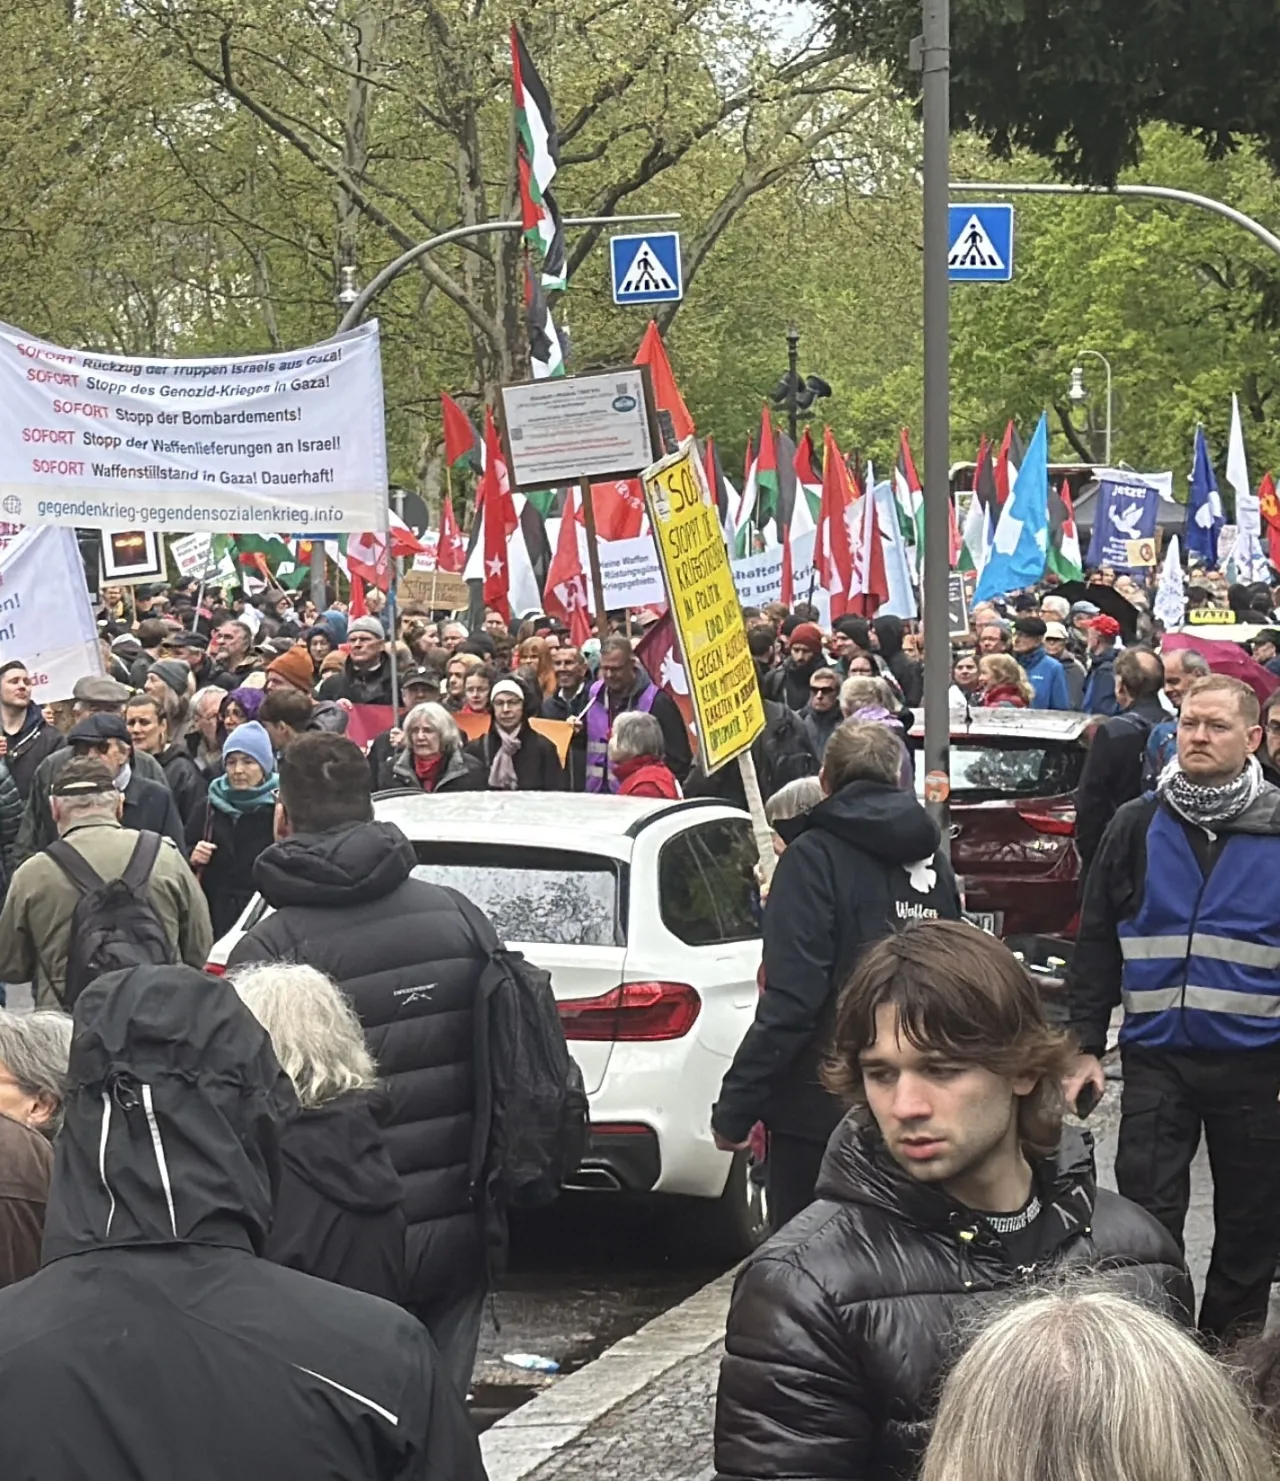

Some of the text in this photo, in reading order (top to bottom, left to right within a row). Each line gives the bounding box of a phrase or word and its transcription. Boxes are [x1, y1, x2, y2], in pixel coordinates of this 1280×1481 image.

[17, 343, 342, 378] SOFORT Rückzug der Truppen Israels aus Gaza!
[27, 368, 330, 398] SOFORT Stopp des Genozid-Krieges in Gaza!
[53, 399, 301, 425] SOFORT Stopp der Bombardements!
[22, 428, 340, 457] SOFORT Stopp der Waffenlieferungen an Israel!
[32, 459, 334, 484] SOFORT Waffenstillstand in Gaza! Dauerhaft!
[38, 500, 343, 524] gegendenkrieg-gegendensozialenkrieg.info
